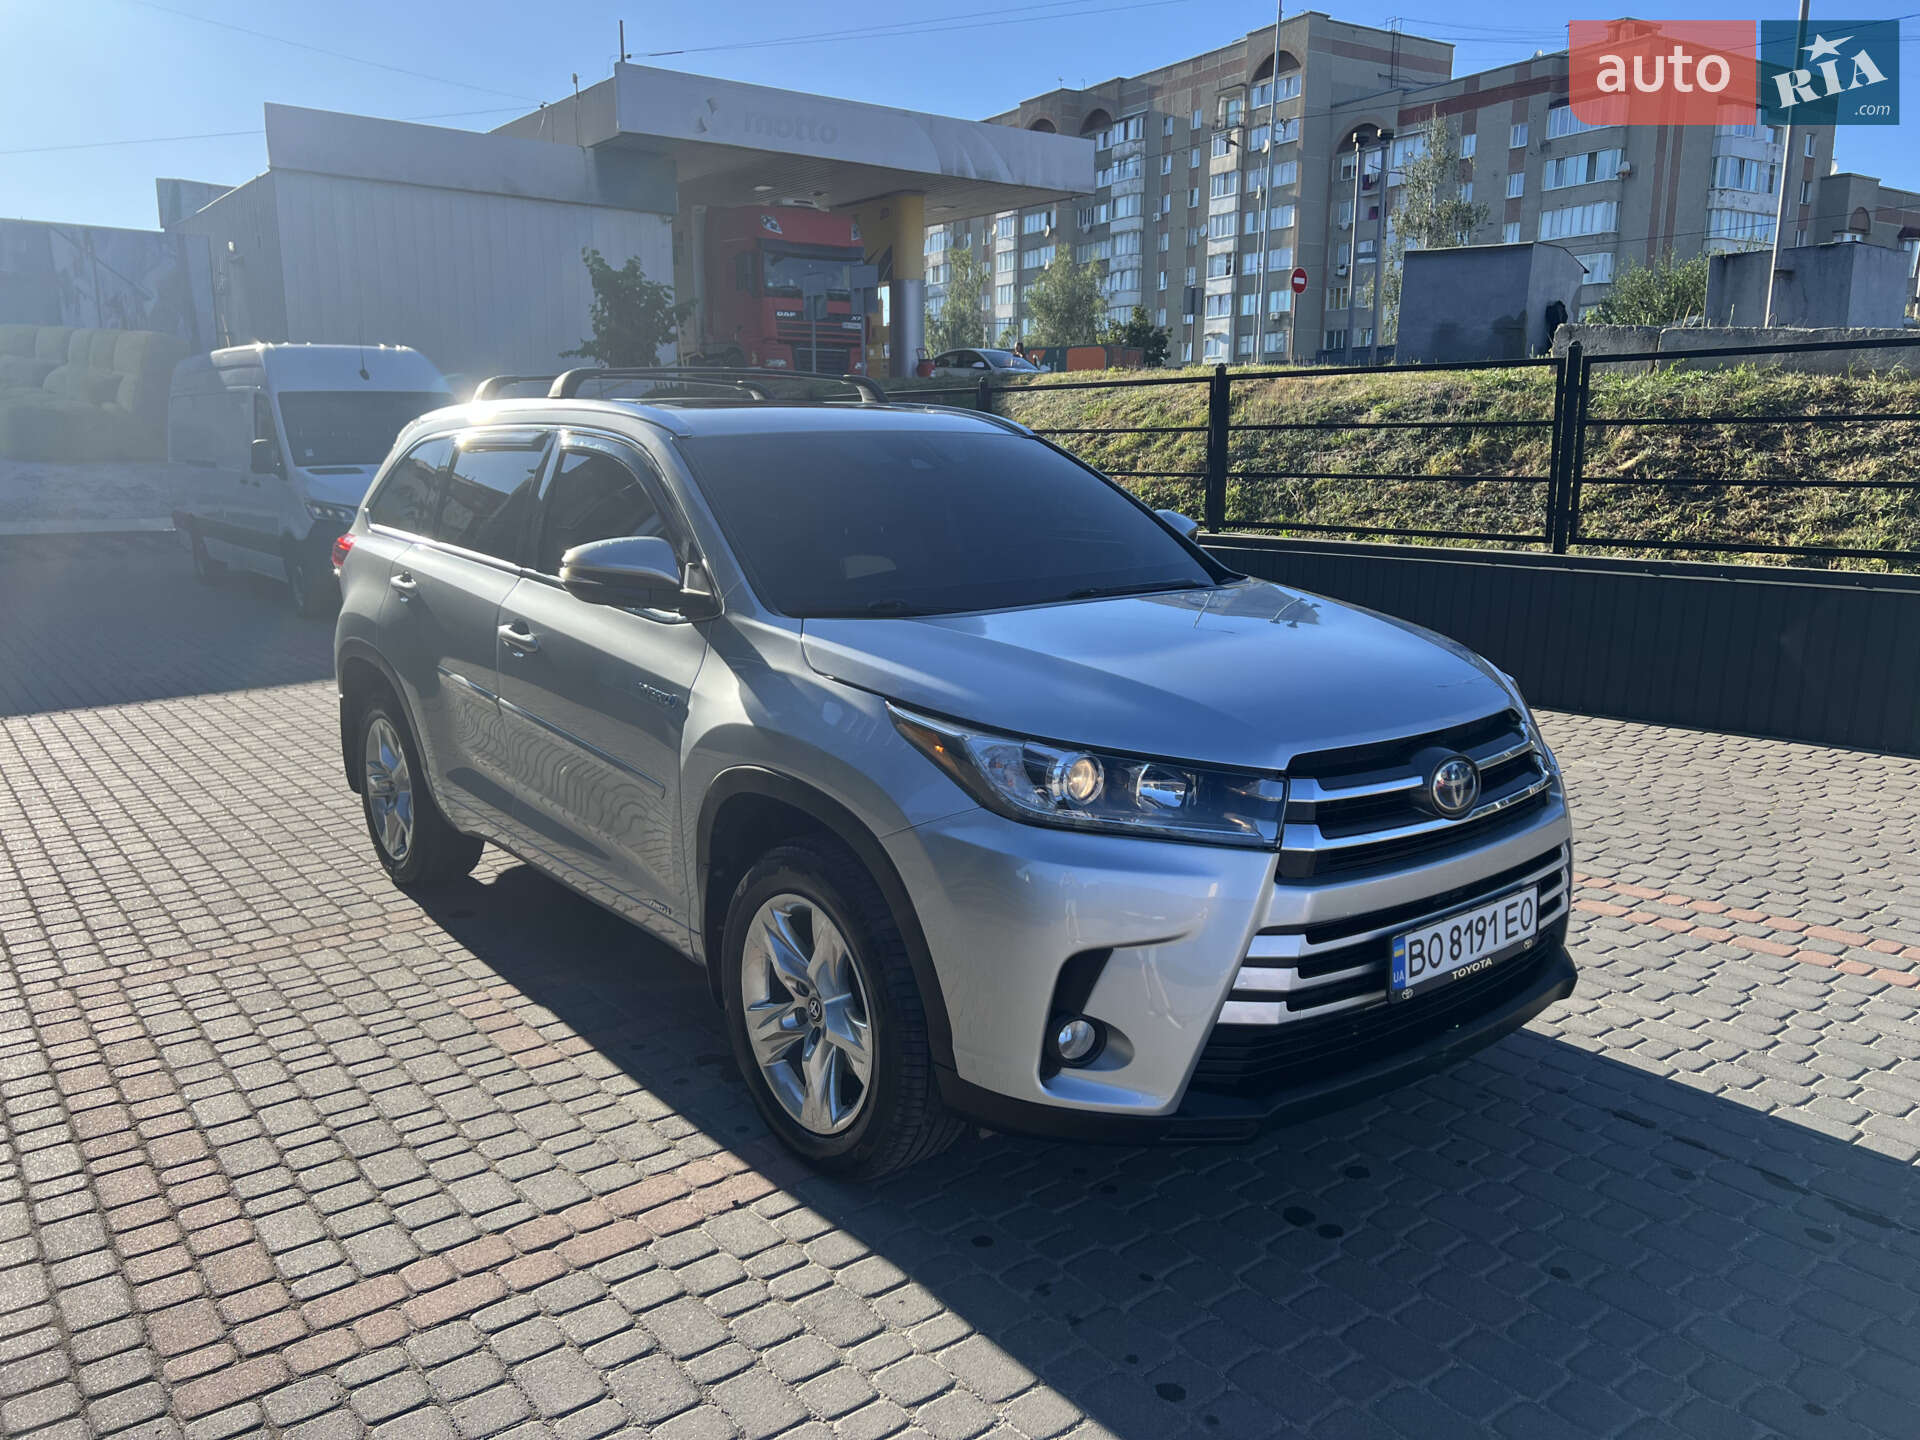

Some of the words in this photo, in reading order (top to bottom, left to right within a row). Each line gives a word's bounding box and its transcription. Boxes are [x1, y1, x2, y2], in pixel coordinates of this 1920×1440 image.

[1450, 910, 1498, 961] 8191
[1393, 970, 1405, 984] UA
[1452, 958, 1493, 980] TOYOTA
